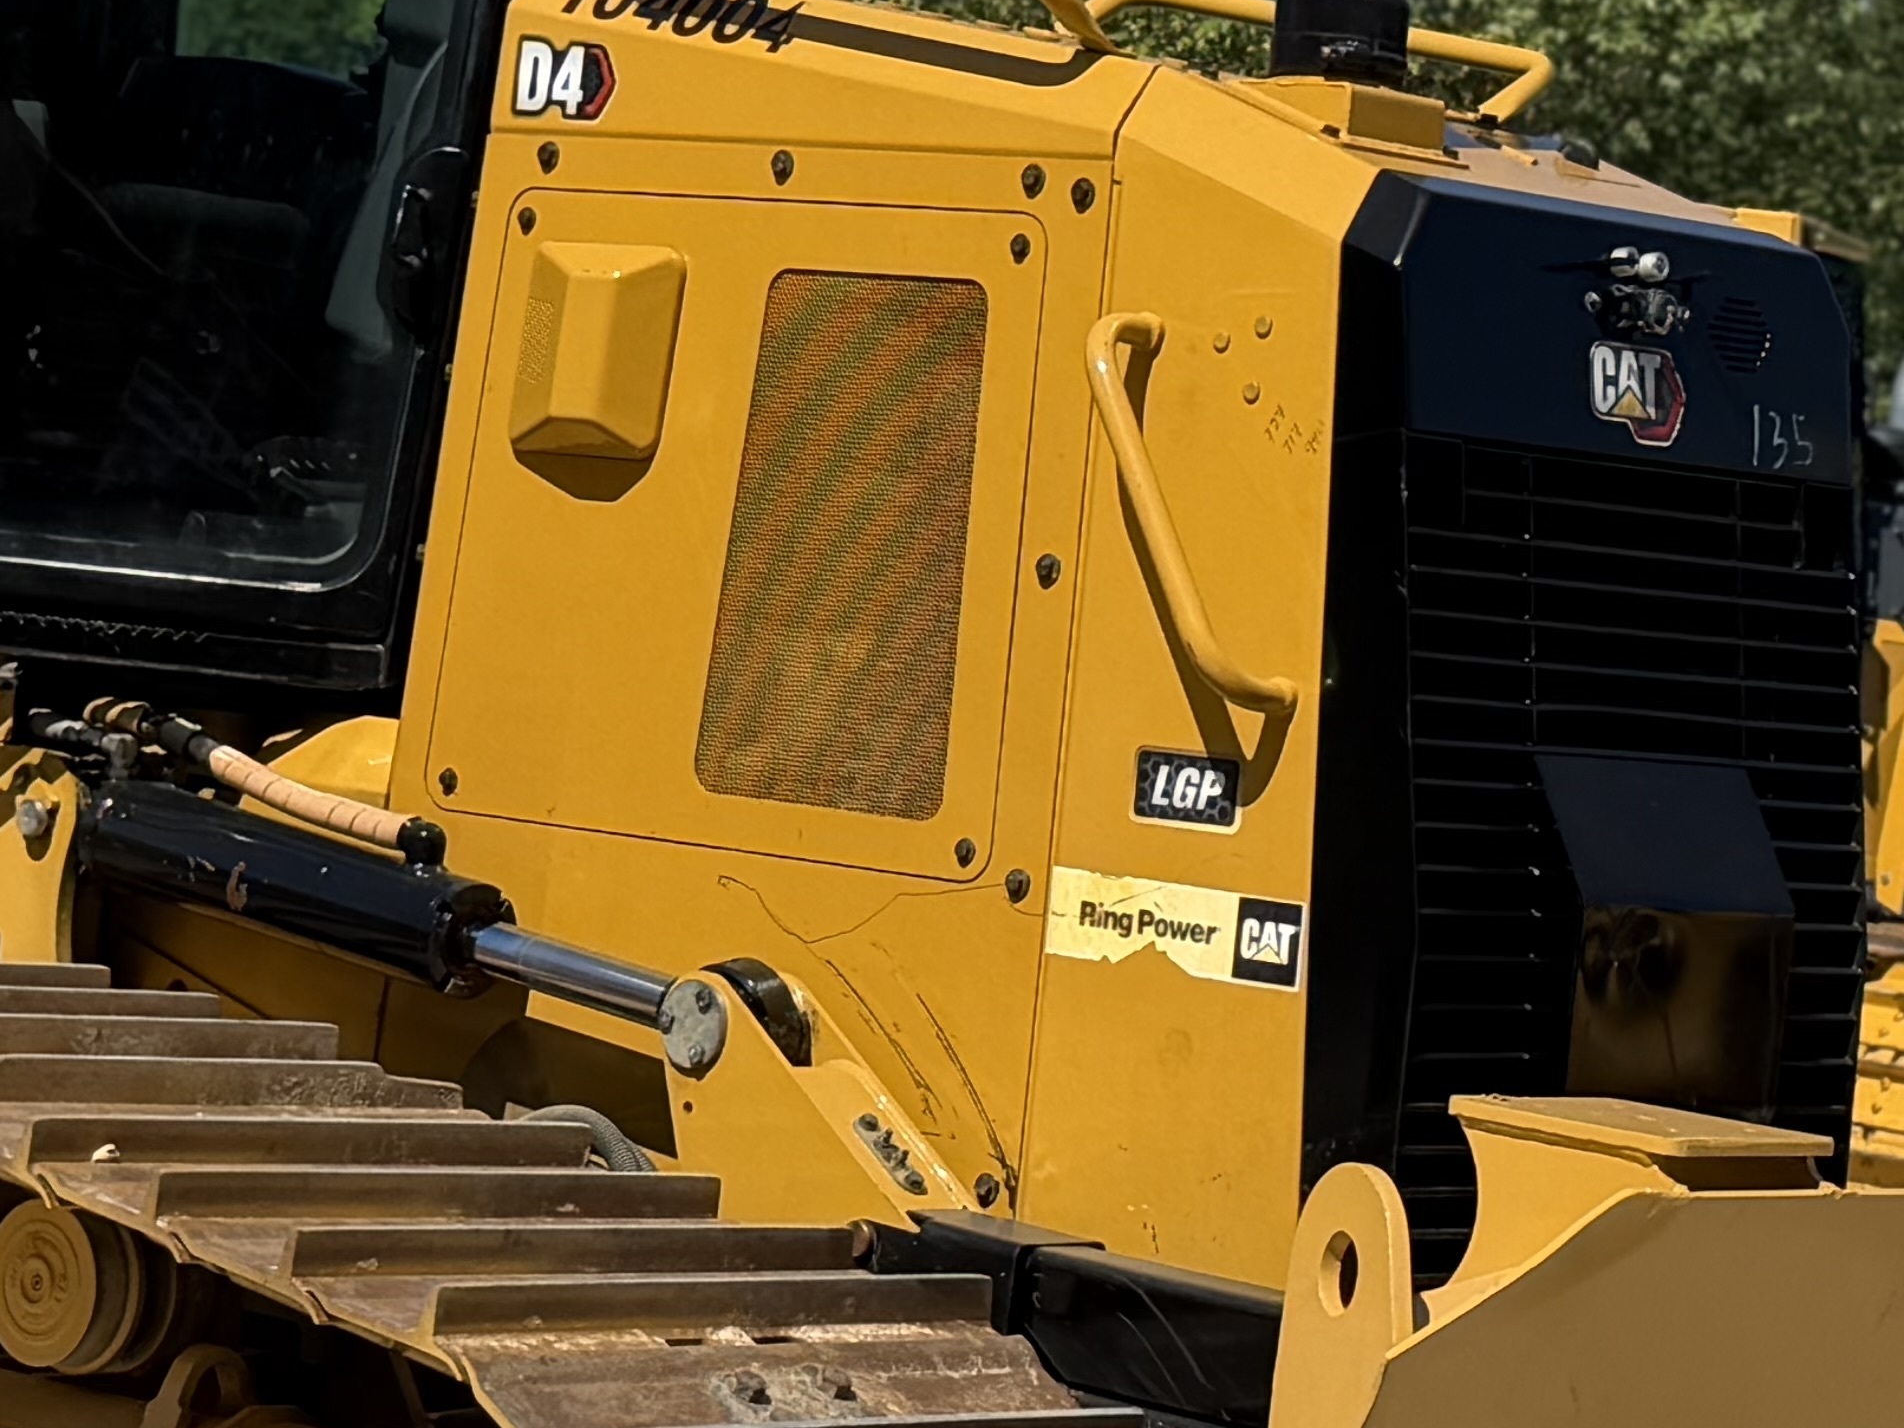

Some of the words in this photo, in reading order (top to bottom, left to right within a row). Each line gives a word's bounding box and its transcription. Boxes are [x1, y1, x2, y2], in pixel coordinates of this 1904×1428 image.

[515, 39, 586, 116] D4
[1593, 345, 1662, 420] CAT
[1753, 403, 1813, 469] 135
[1151, 765, 1226, 811] LGP
[1078, 900, 1134, 939] Ring
[1137, 909, 1217, 945] Power
[1239, 918, 1298, 966] CAT
